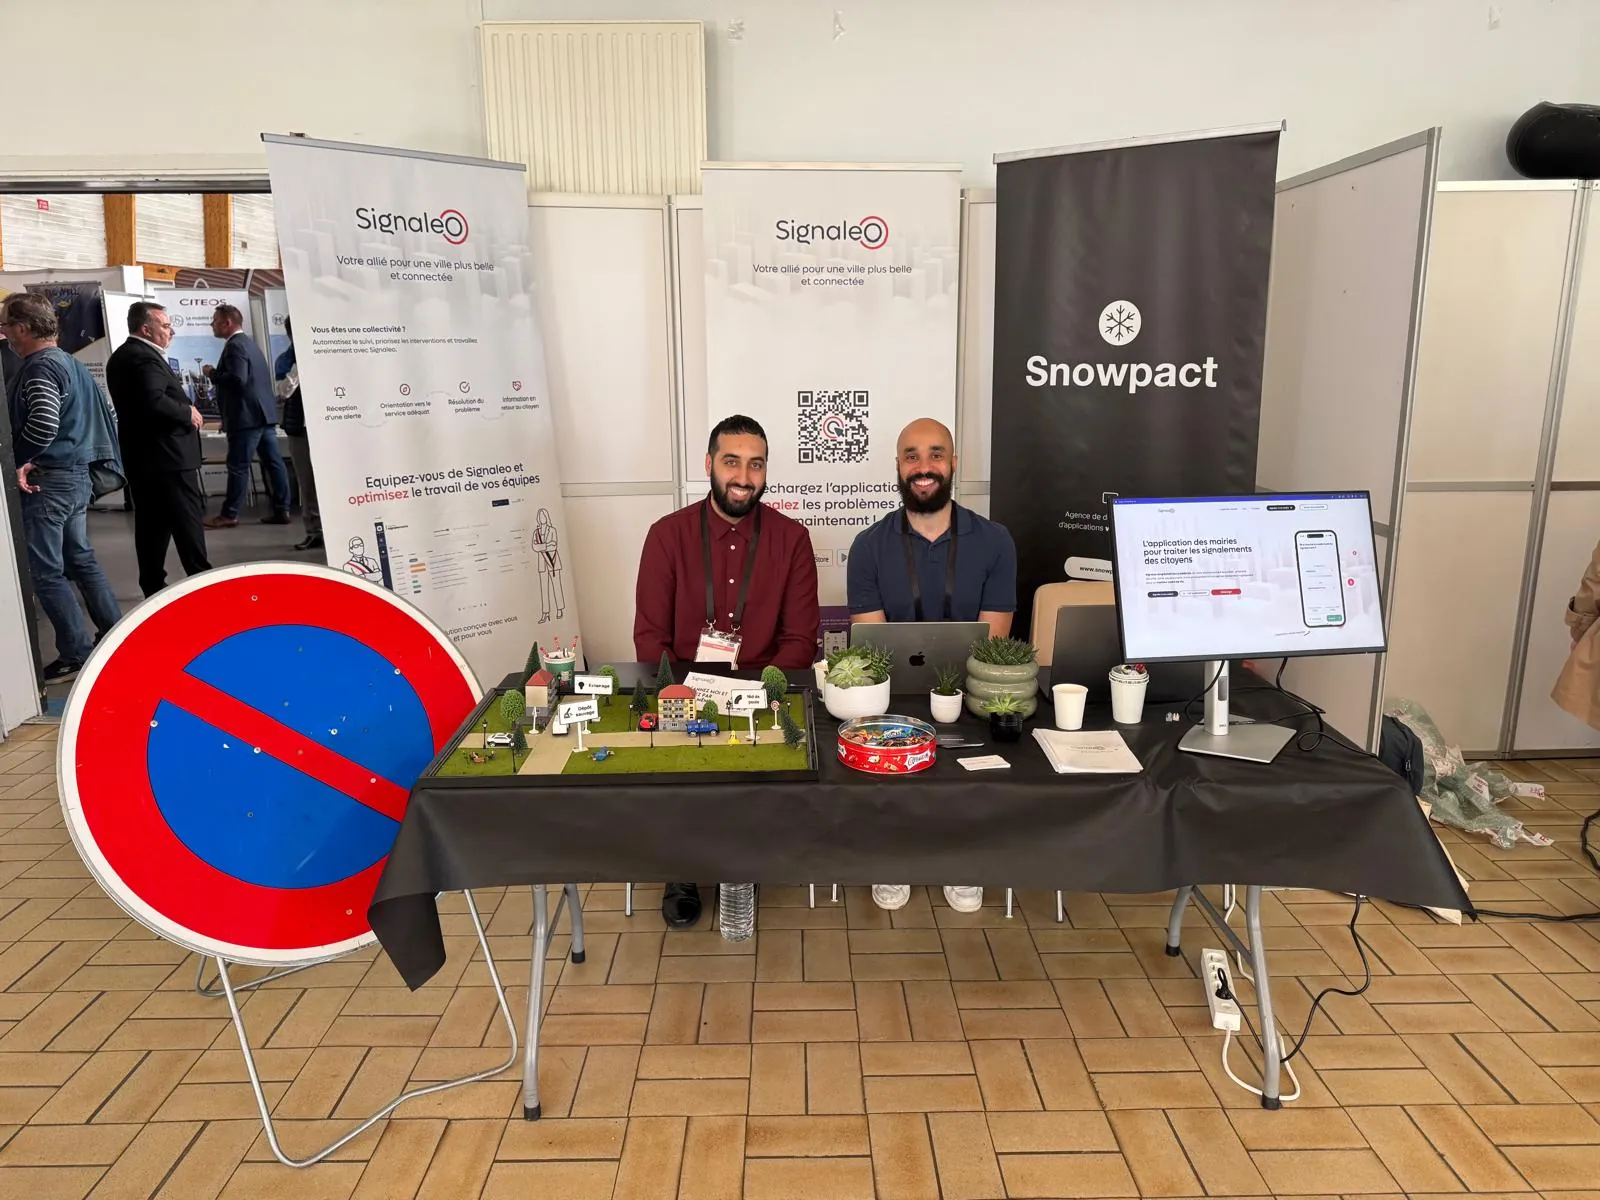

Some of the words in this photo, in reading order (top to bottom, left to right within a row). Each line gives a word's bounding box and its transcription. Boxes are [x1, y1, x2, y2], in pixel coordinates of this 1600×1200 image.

[337, 256, 364, 265] Votre
[367, 256, 387, 266] allié
[390, 259, 410, 268] pour
[434, 260, 452, 268] ville
[455, 261, 472, 271] plus
[475, 262, 494, 271] belle
[753, 264, 778, 273] Votre
[780, 264, 800, 273] allié
[802, 266, 824, 274] pour
[847, 264, 865, 273] ville
[868, 264, 886, 274] plus
[889, 264, 912, 273] belle
[402, 272, 452, 281] connectée
[813, 277, 864, 285] connectée
[1026, 355, 1218, 394] Snowpact
[366, 470, 445, 489] Equipez-vous
[448, 469, 463, 479] de
[466, 464, 512, 478] Signaleo
[514, 462, 524, 472] et
[348, 488, 409, 507] optimisez
[412, 487, 422, 497] le
[424, 482, 462, 496] travail
[464, 481, 479, 491] de
[481, 480, 500, 490] vos
[502, 474, 540, 488] équipes
[803, 499, 821, 509] les
[825, 499, 895, 512] problèmes
[1065, 511, 1090, 519] Agence
[1059, 522, 1104, 531] d'applications
[1143, 539, 1192, 548] L'application
[1202, 545, 1252, 555] signalements
[1160, 556, 1192, 565] citoyens
[461, 633, 476, 641] pour
